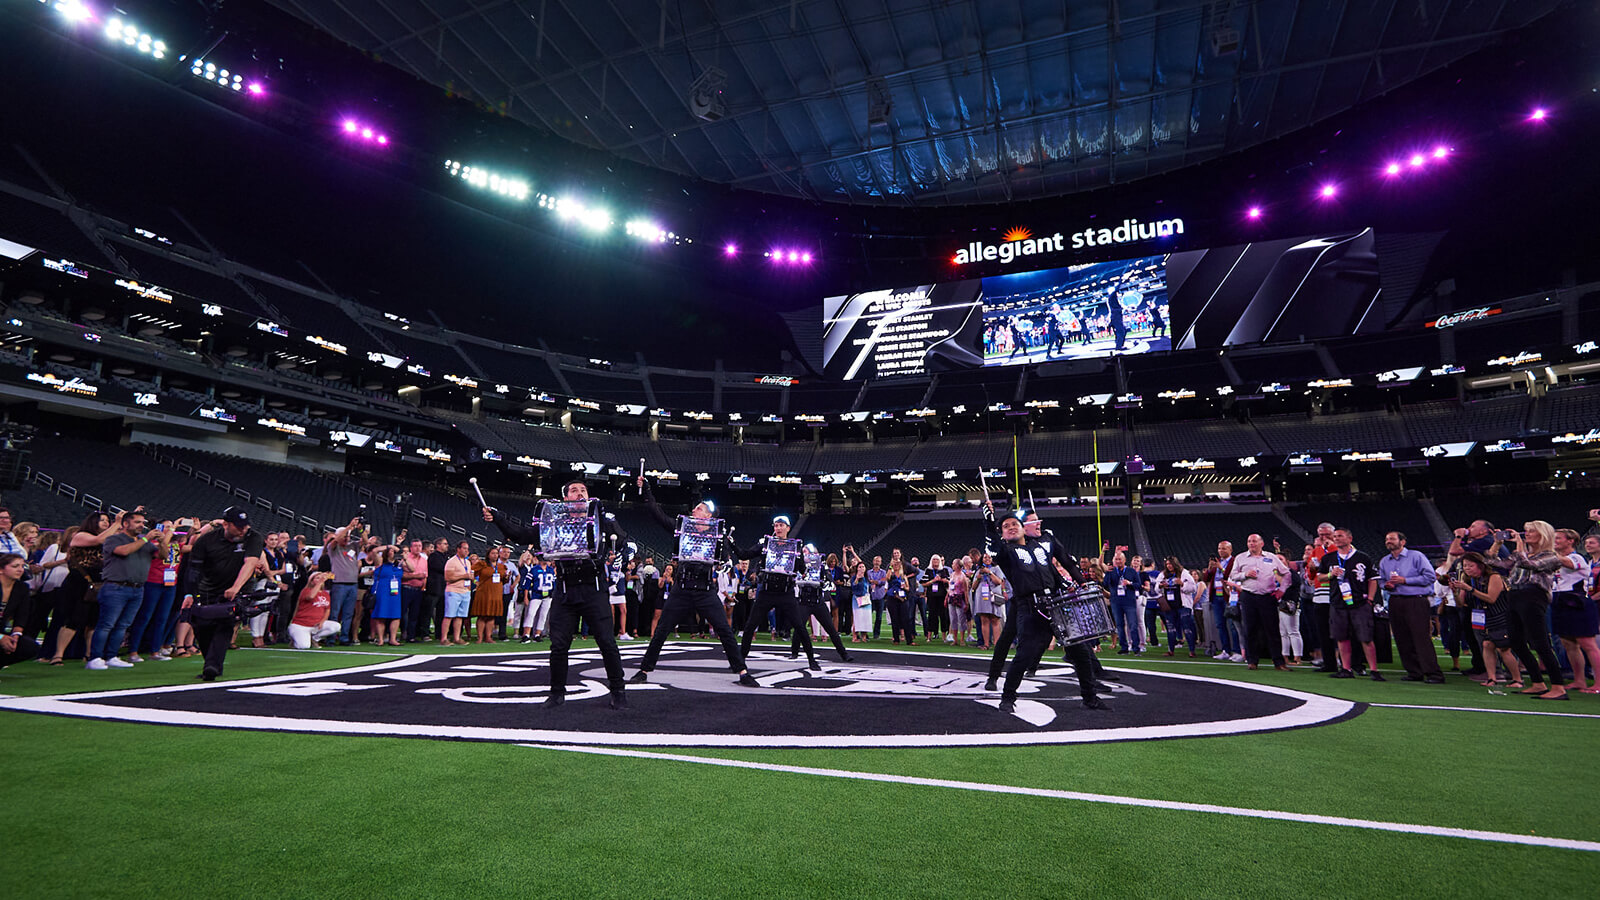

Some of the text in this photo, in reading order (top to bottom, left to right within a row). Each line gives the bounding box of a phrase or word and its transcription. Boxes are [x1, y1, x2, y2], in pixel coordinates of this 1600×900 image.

[955, 218, 1183, 264] allegiant stadium
[1435, 307, 1491, 329] Coca-Cola
[760, 375, 794, 387] Coca-Cola
